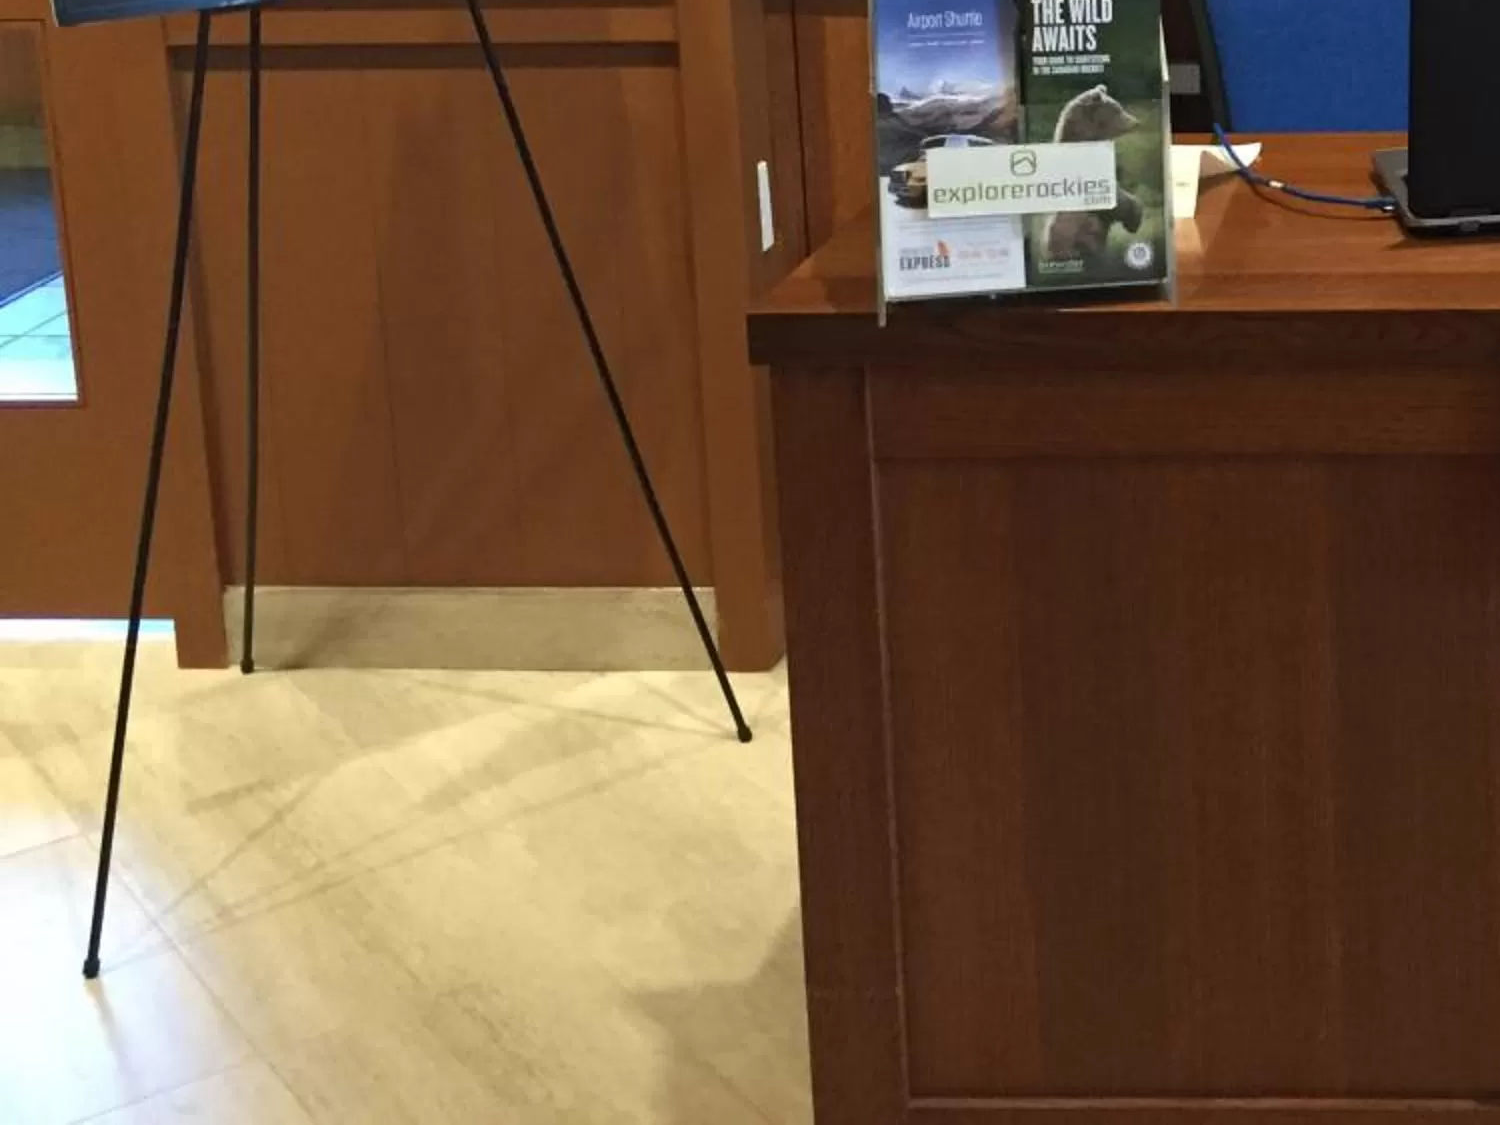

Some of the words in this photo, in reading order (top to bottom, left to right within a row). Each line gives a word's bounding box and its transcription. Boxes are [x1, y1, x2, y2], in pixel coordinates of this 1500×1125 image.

[906, 12, 943, 30] Airport
[1032, 24, 1097, 52] AWAITS
[933, 177, 1111, 204] explorerockies
